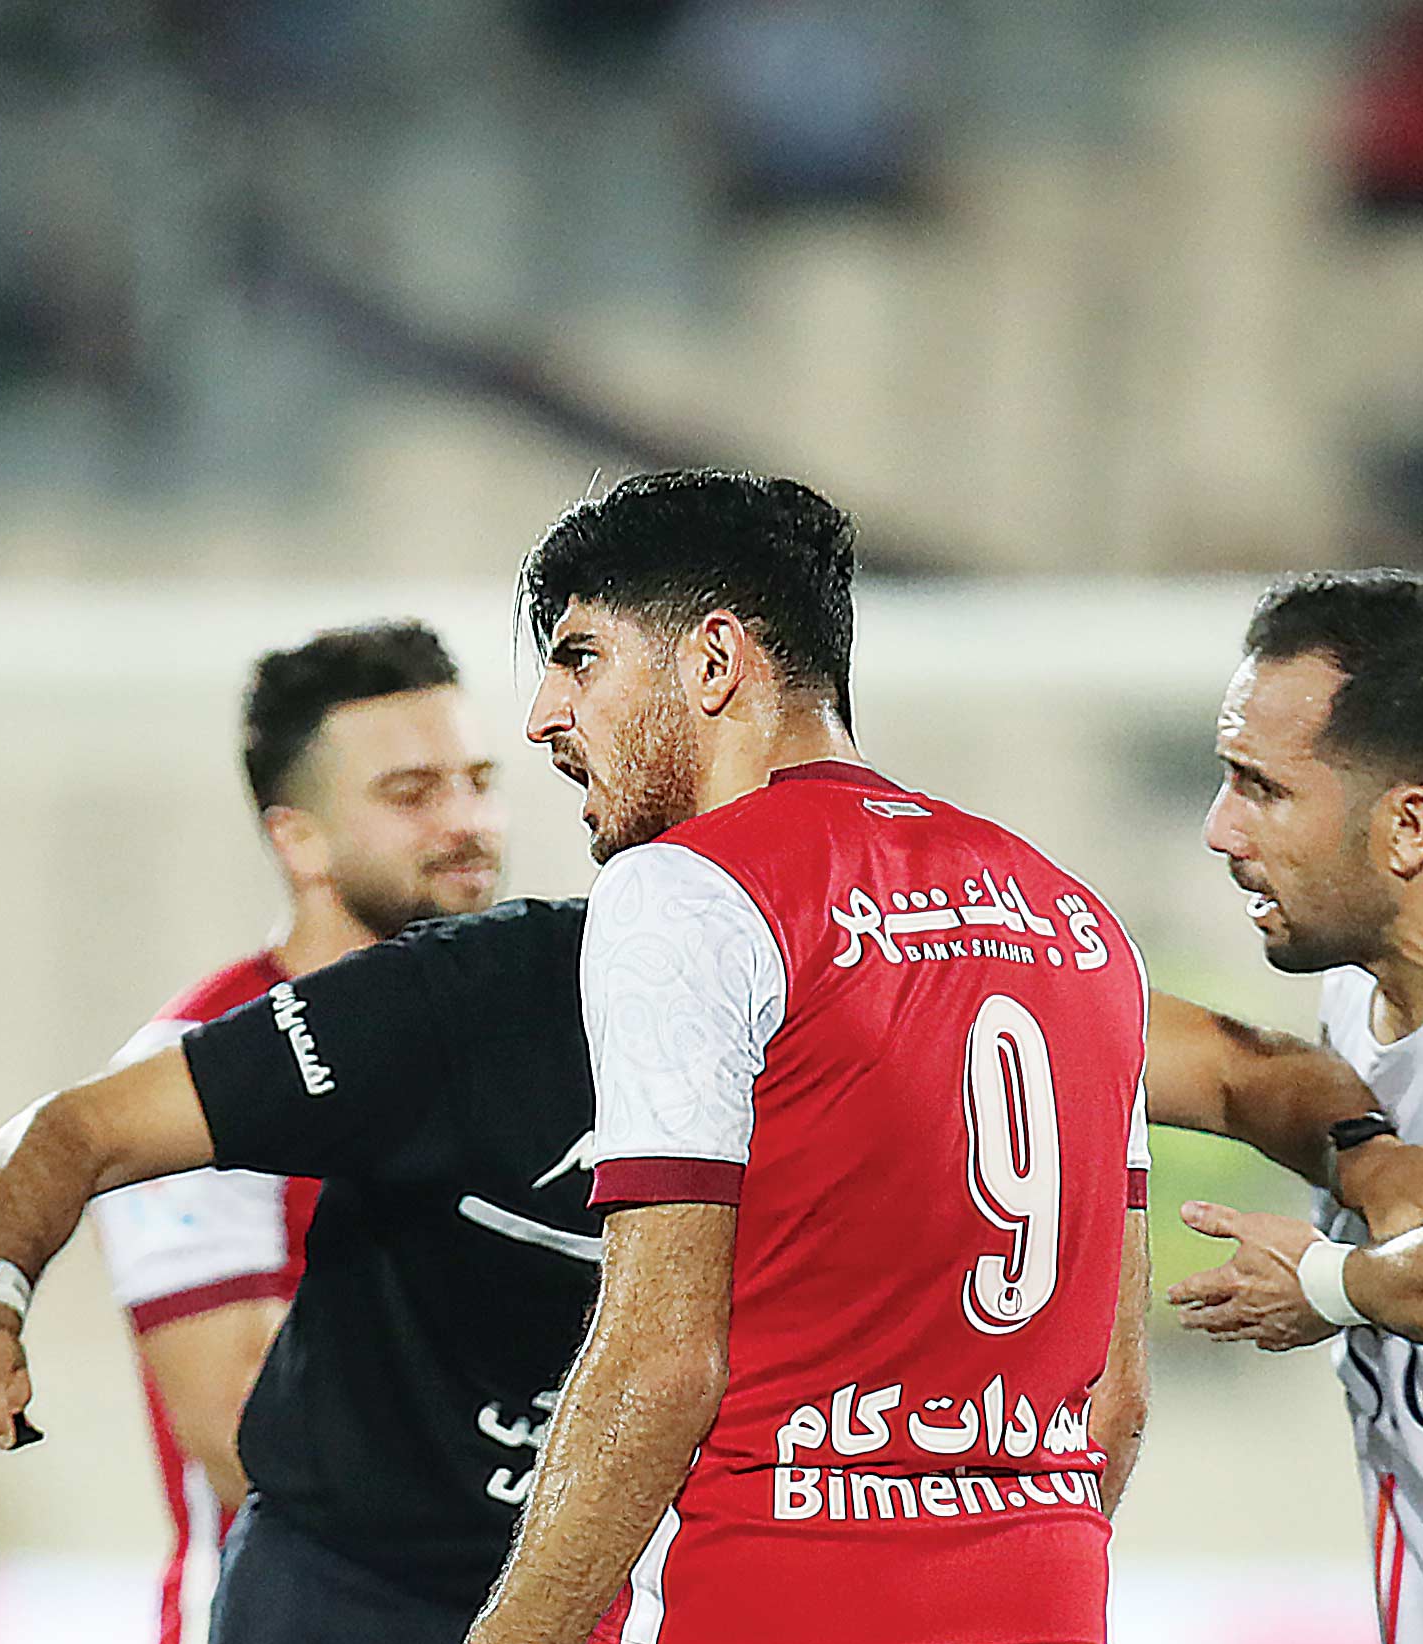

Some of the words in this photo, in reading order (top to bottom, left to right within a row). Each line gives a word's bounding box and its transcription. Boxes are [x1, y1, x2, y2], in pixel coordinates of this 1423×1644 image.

[905, 940, 968, 962] BANK
[972, 938, 1035, 964] SHAHR
[963, 994, 1060, 1335] 9
[775, 1383, 903, 1465] کام
